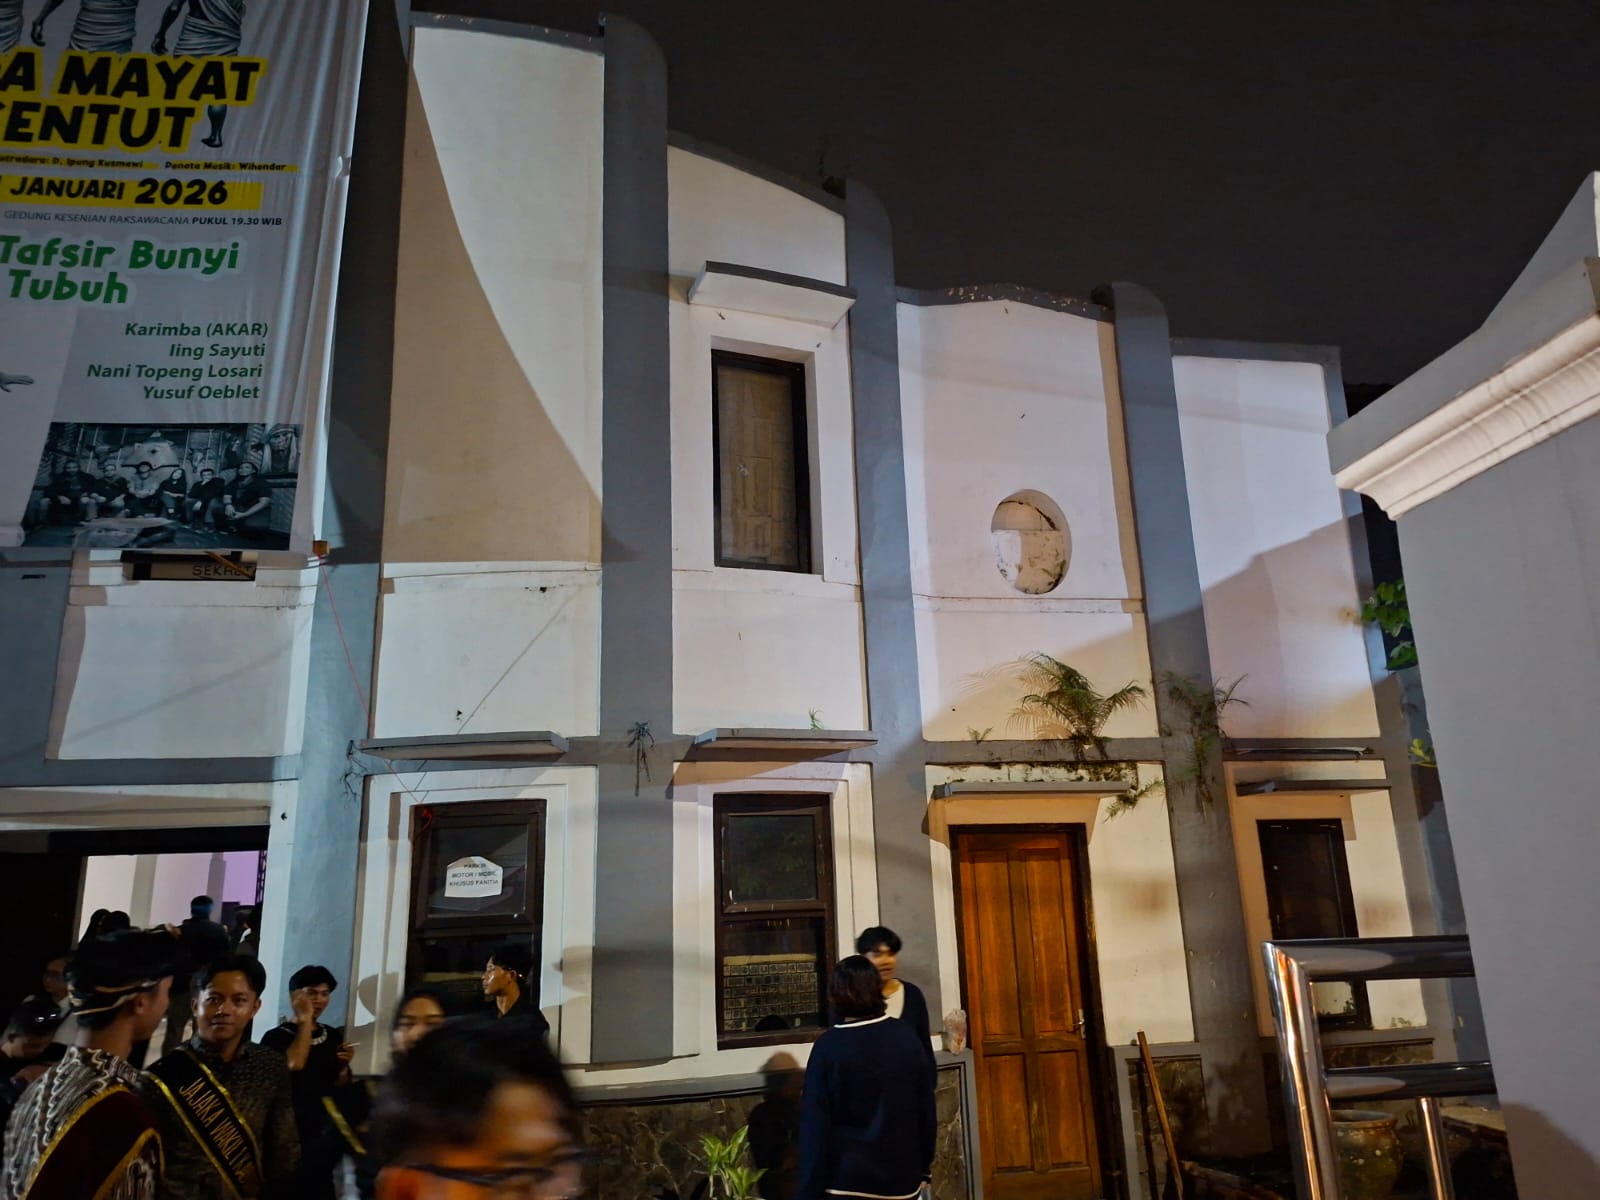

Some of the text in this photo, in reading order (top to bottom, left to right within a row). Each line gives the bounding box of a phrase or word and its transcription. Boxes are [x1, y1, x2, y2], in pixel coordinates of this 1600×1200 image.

[0, 52, 260, 101] A MAYAT
[0, 102, 195, 148] ENTUT
[10, 176, 125, 200] JANUARI
[134, 178, 228, 205] 2026
[4, 210, 282, 226] GEDUNG KESENIAN RAKSAWACANA PUKUL 19.30 WIB
[0, 235, 240, 275] Tafsir Bunyi
[8, 269, 129, 304] Tubuh
[125, 322, 268, 338] Karimba (AKAR)
[209, 343, 266, 360] Sayuti
[87, 364, 263, 381] Nani Topeng Losari
[143, 385, 260, 400] Yusuf Oeblet
[179, 1077, 225, 1128] JAJAKA
[209, 1116, 244, 1160] WAKIL
